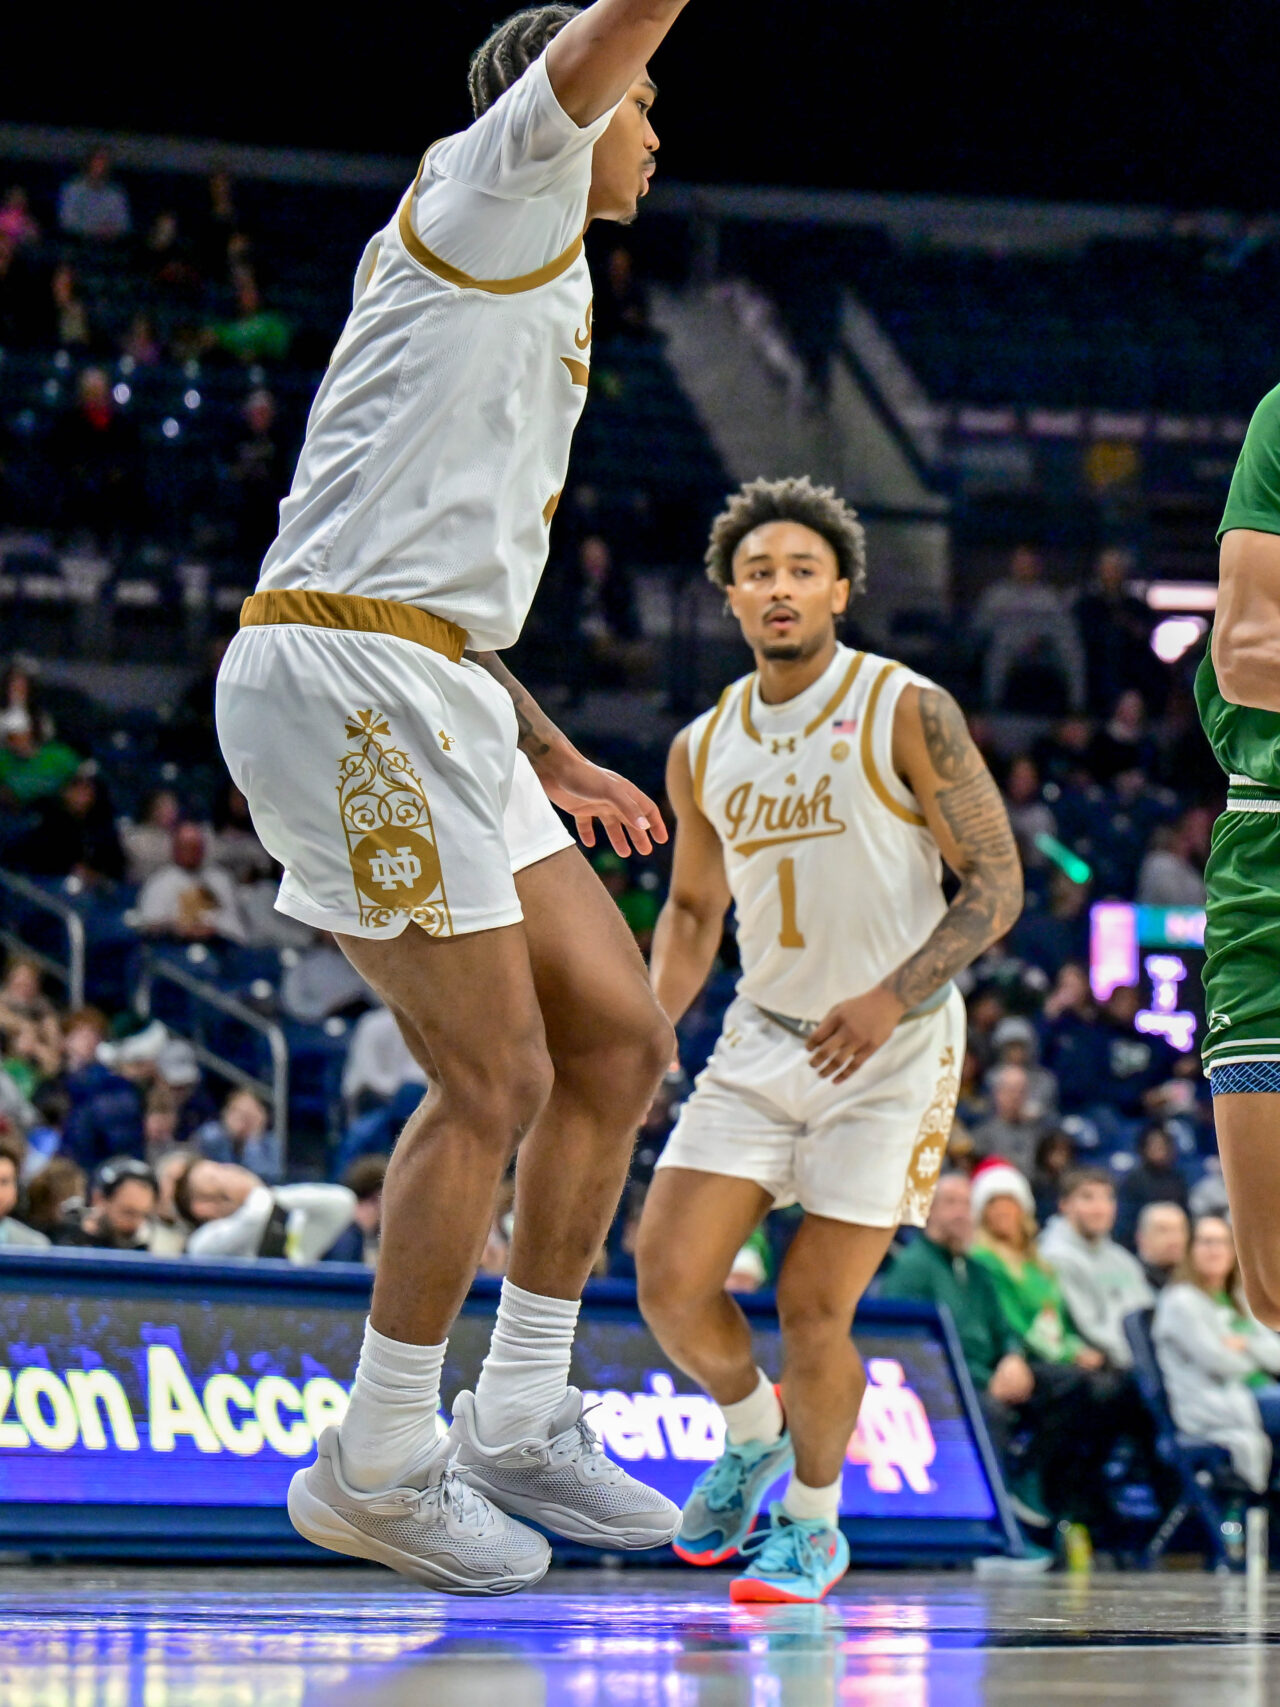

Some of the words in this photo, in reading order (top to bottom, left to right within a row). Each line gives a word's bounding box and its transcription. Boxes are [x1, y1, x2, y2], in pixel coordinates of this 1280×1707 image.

[725, 774, 846, 841] Irish
[777, 857, 806, 948] 1
[147, 1343, 358, 1457] Acce
